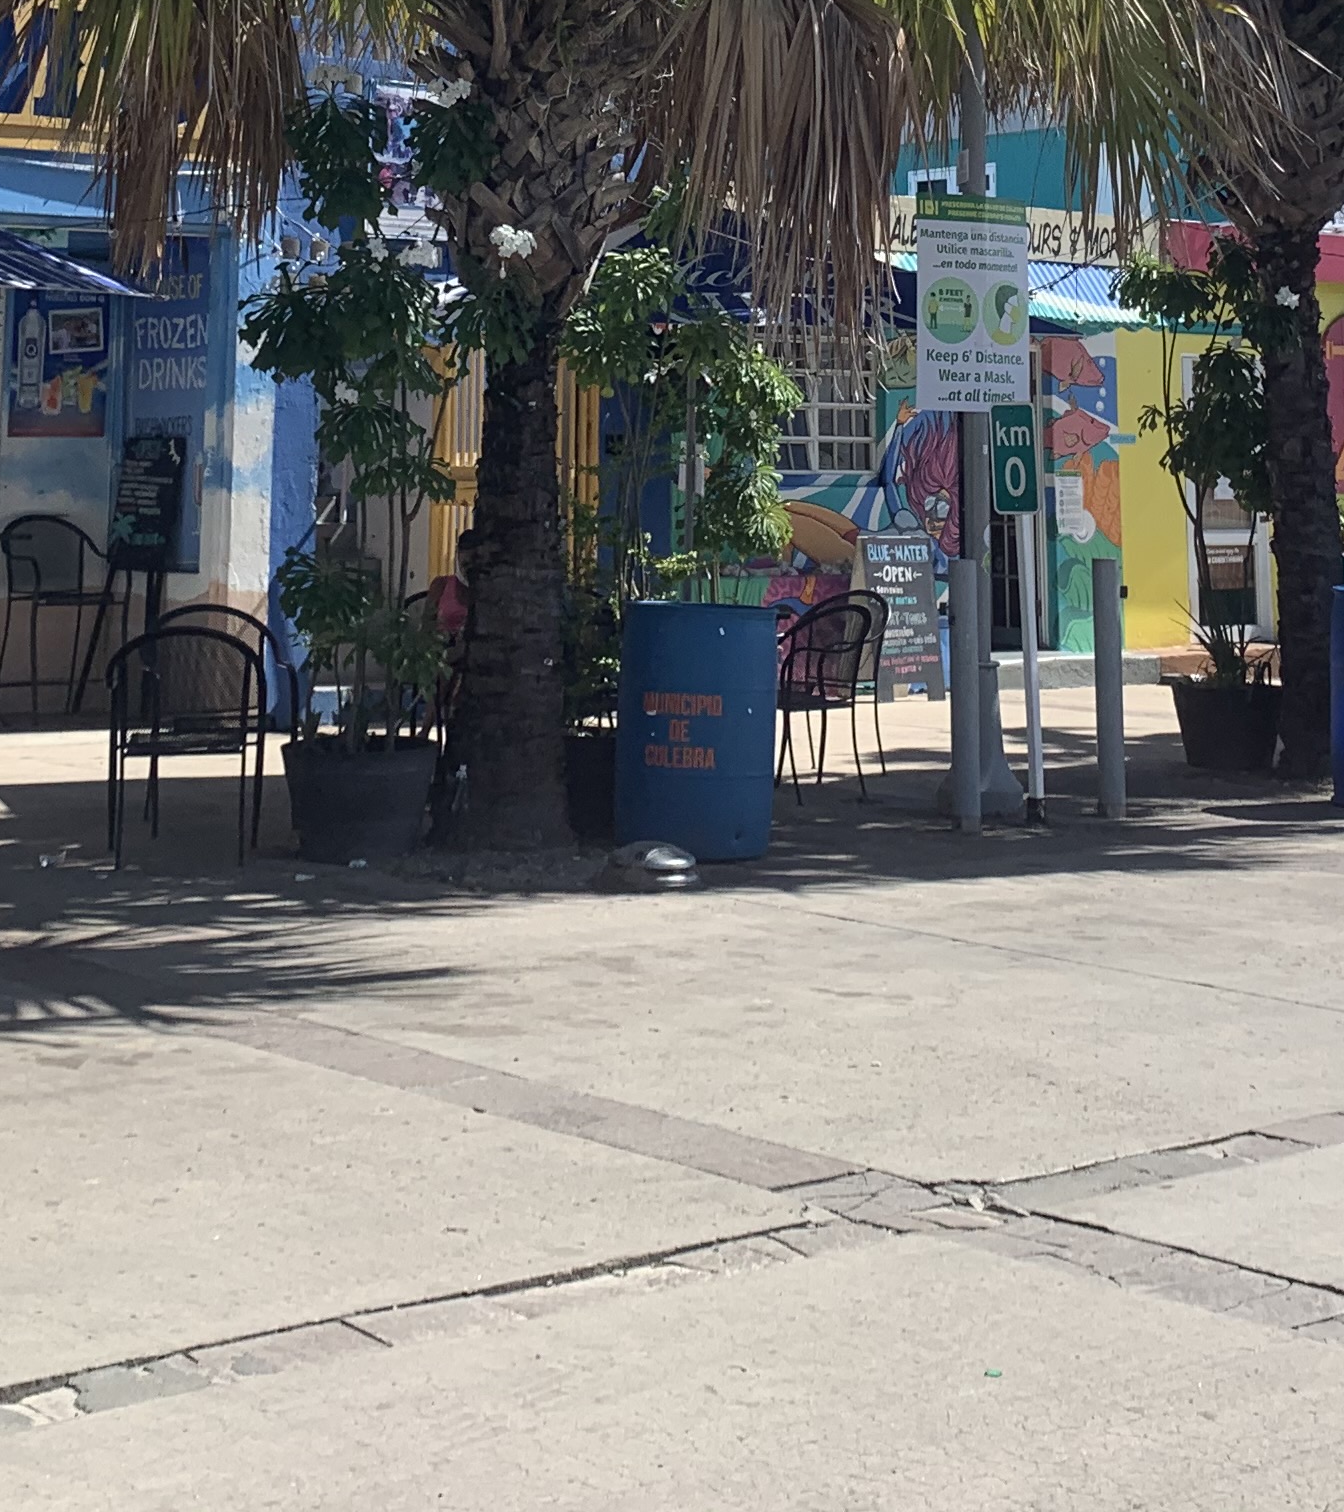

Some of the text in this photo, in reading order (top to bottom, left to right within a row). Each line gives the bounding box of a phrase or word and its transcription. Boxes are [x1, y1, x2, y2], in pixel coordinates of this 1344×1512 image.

[920, 229, 968, 242] Mantenga
[970, 233, 987, 242] una
[936, 244, 967, 256] Utilice
[955, 260, 977, 270] todo
[945, 289, 964, 297] FEET
[134, 313, 209, 350] FROZEN
[926, 348, 959, 366] Keep
[975, 350, 1025, 366] Distance.
[138, 355, 207, 392] DRINKS
[938, 369, 1016, 384] Wear a Mask.
[964, 389, 981, 402] all
[982, 389, 1015, 403] times!
[995, 420, 1031, 447] km
[1004, 456, 1027, 498] 0
[867, 544, 929, 562] BLUE WATER
[882, 564, 913, 583] OPEN
[668, 719, 691, 743] DE
